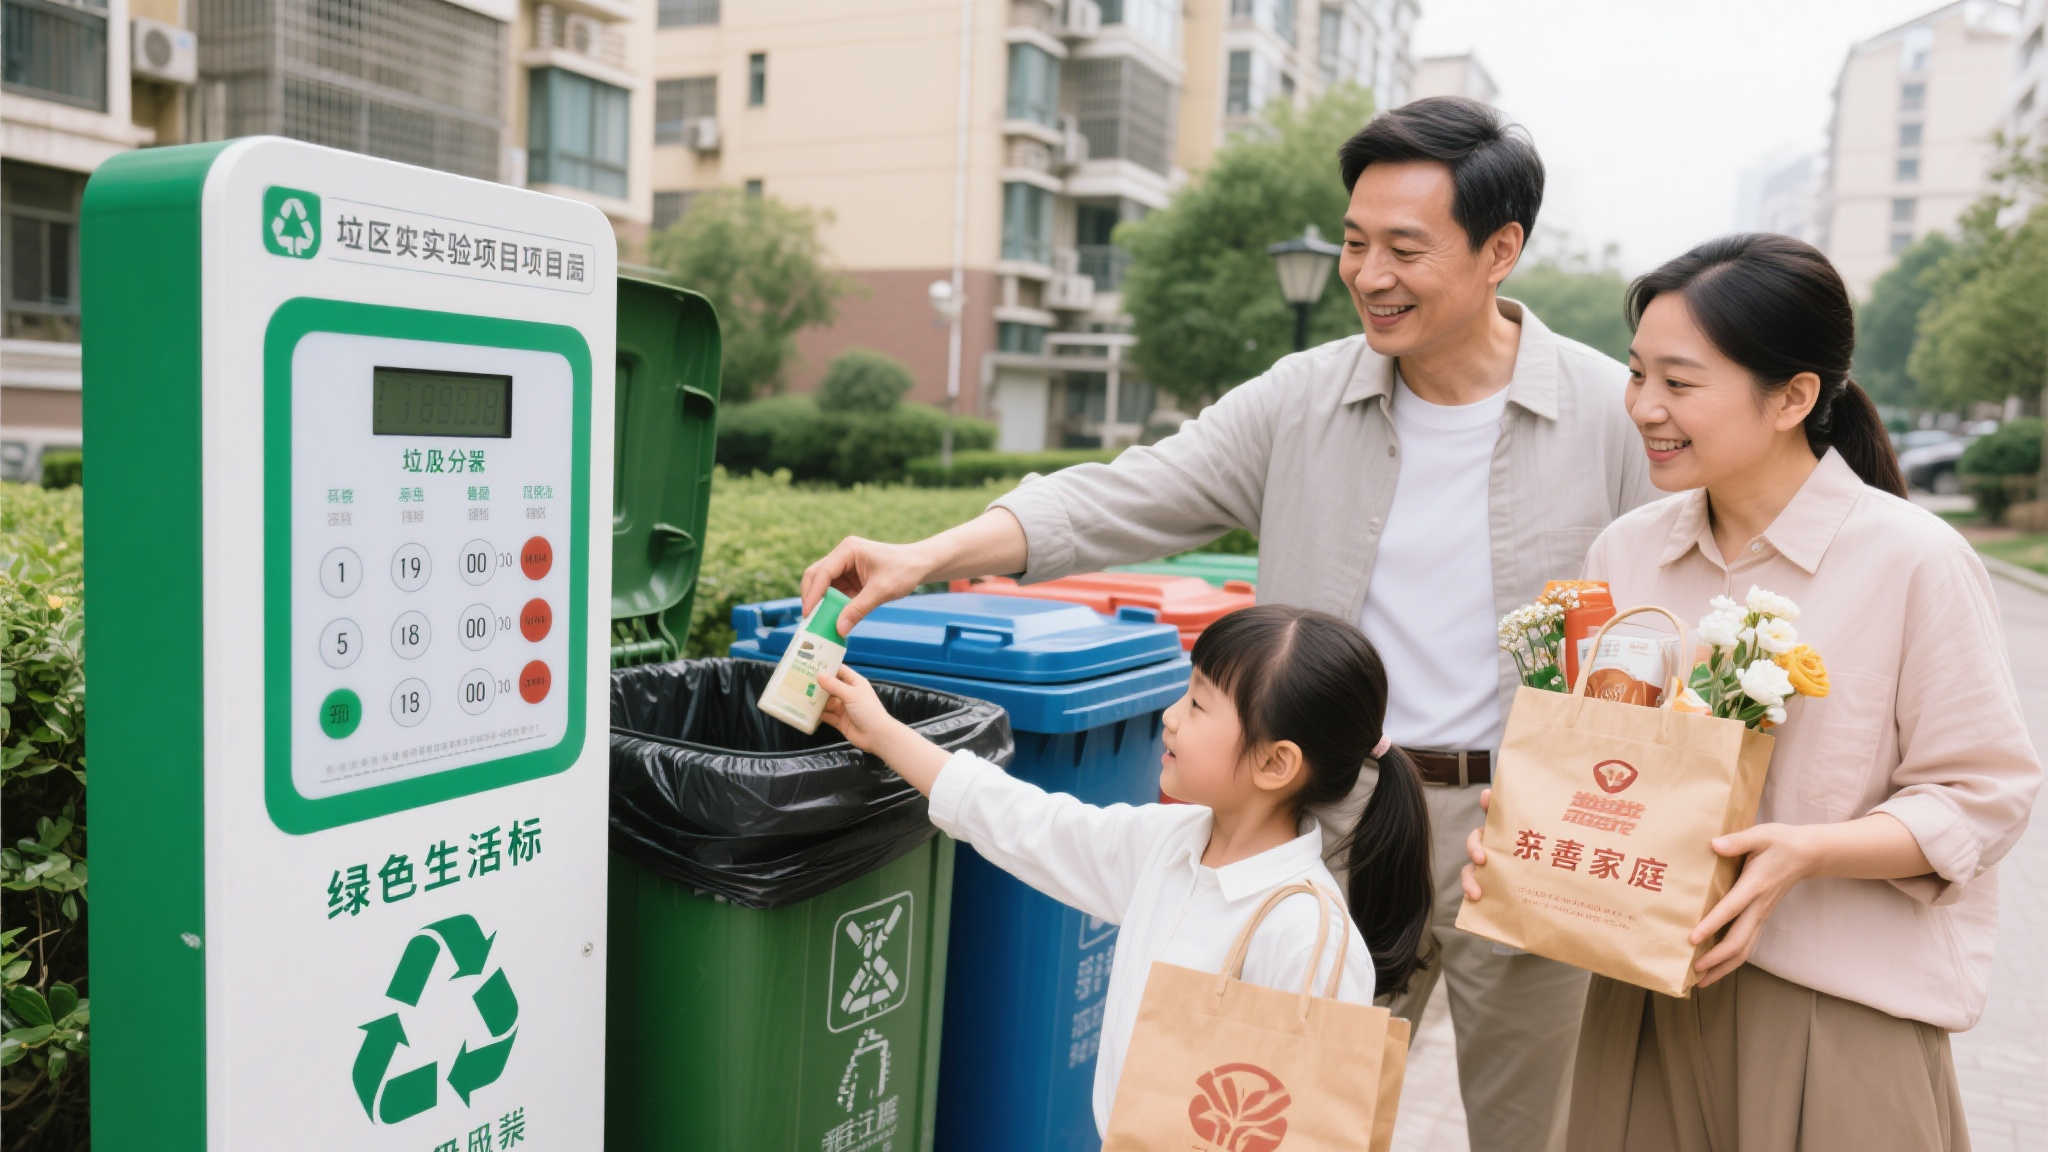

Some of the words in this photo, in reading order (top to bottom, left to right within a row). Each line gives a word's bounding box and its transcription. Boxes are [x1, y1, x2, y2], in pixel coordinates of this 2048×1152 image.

[337, 562, 345, 583] 1
[400, 557, 421, 579] 19
[467, 552, 487, 573] 00
[336, 632, 348, 655] 5
[401, 624, 420, 646] 18
[466, 617, 486, 639] 00
[465, 681, 486, 703] 00
[327, 817, 542, 920] 绿色生活标
